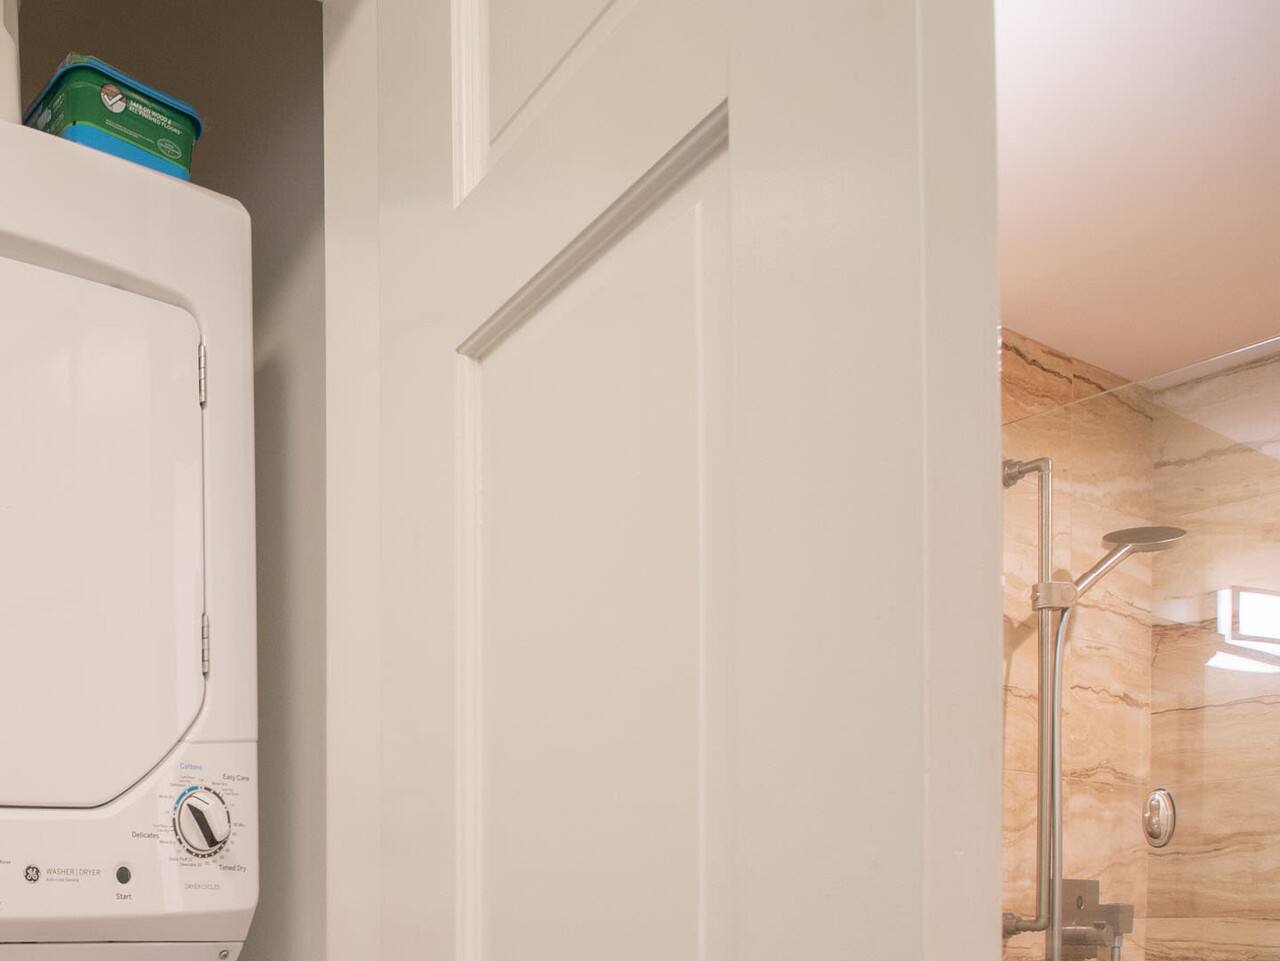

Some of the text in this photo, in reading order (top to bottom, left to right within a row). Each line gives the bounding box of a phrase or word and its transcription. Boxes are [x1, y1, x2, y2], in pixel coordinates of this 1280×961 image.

[222, 773, 236, 781] Easy
[132, 831, 160, 839] Delicates
[46, 868, 101, 876] WASHER DRYER
